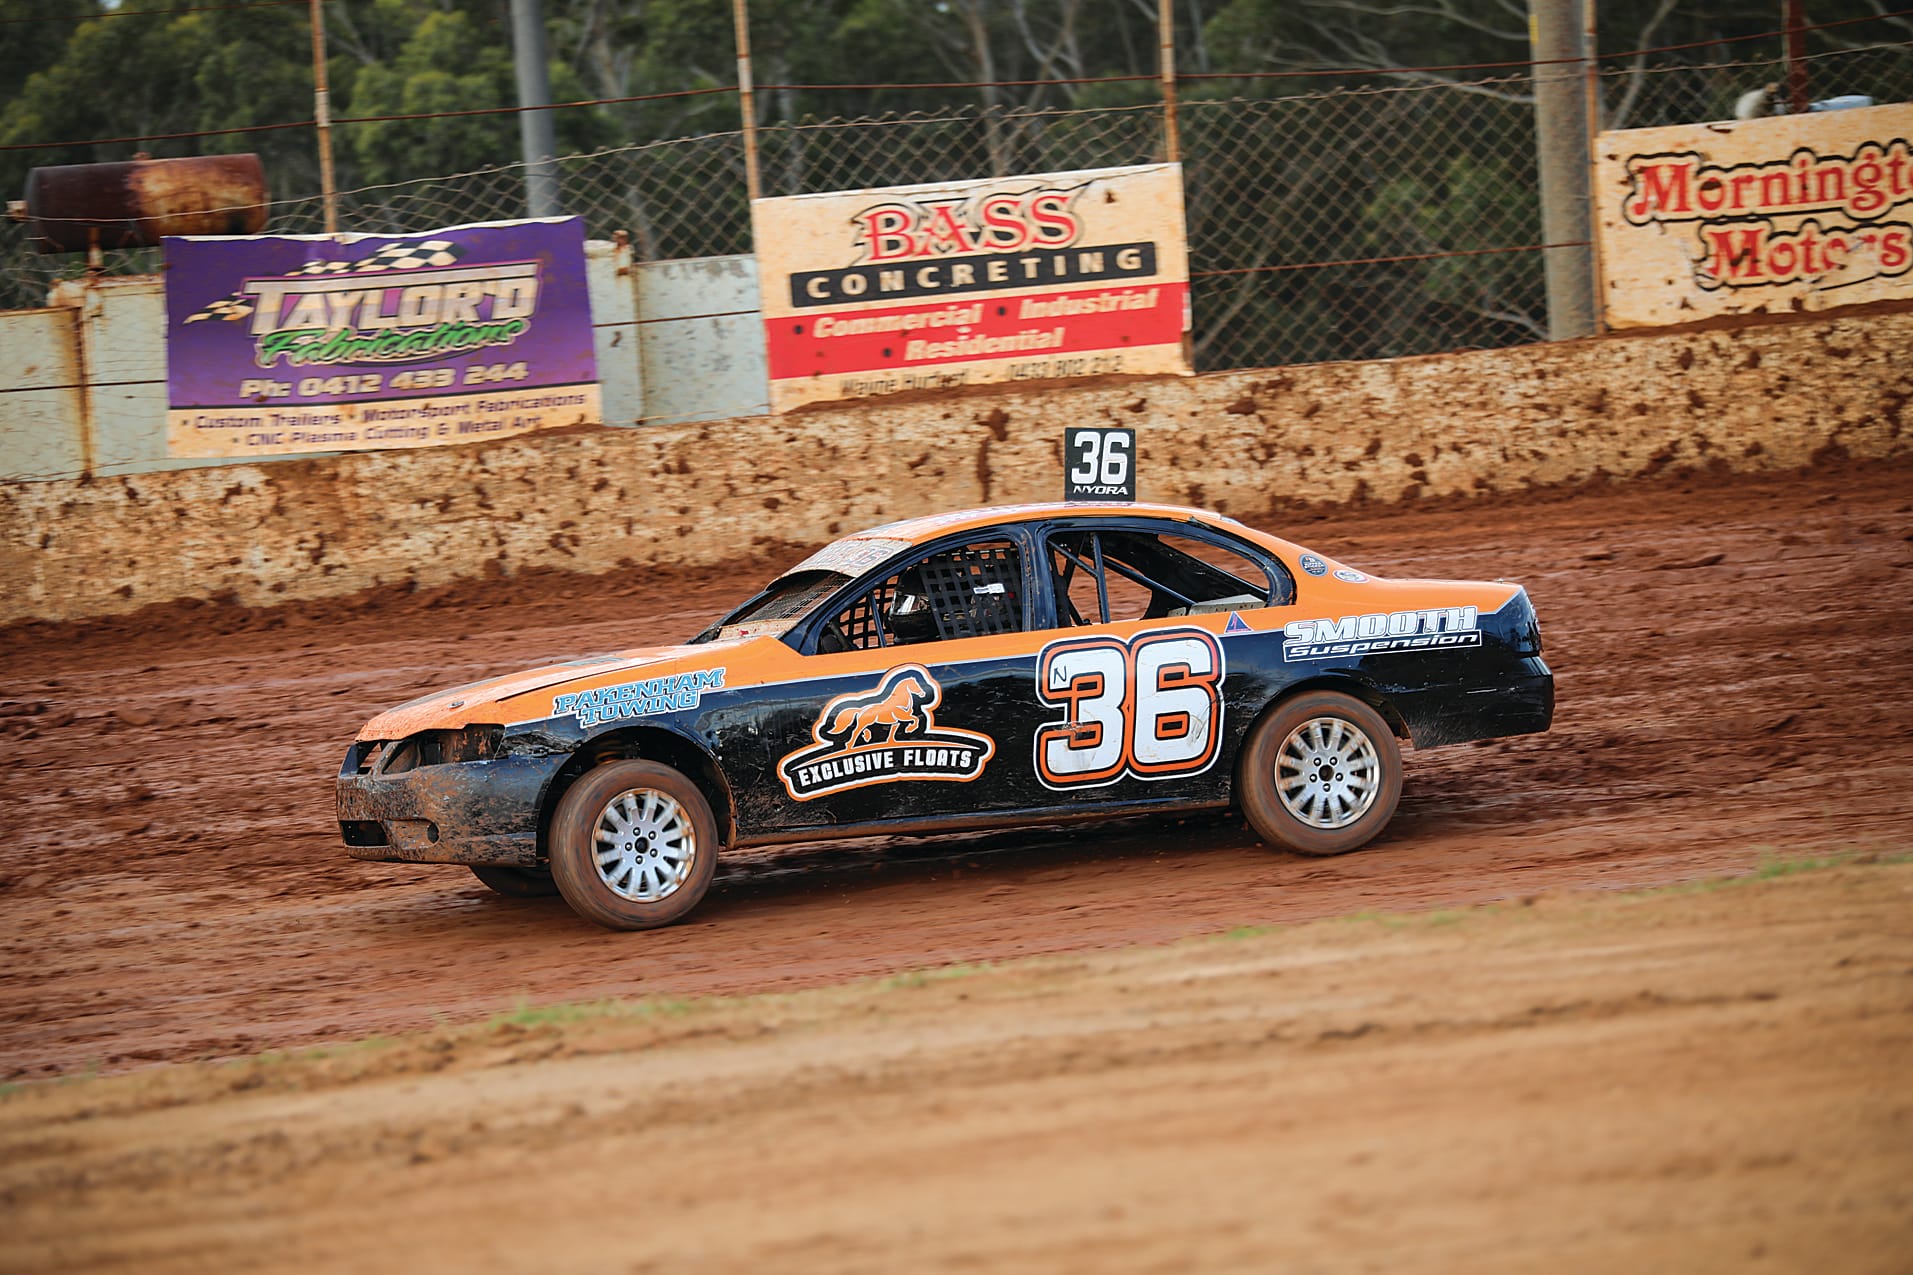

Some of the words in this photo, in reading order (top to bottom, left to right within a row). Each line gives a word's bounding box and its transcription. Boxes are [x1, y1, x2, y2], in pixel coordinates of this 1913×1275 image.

[1632, 151, 1913, 215] Morningt
[862, 194, 1079, 262] BASS
[806, 247, 1143, 298] CONCRETING
[243, 262, 540, 336] TAYLOR'D
[812, 303, 984, 339] Commercial
[1018, 288, 1159, 320] Industrial
[260, 319, 527, 364] Fabrications
[904, 327, 1065, 361] Residential
[240, 378, 292, 398] Ph:
[297, 374, 383, 397] 0412
[389, 367, 456, 390] 433
[463, 361, 529, 385] 244
[195, 414, 263, 429] Custom
[269, 412, 341, 428] Trailers
[363, 402, 470, 421] Motorsport
[477, 393, 587, 413] Fabrications
[247, 432, 284, 446] CNC
[291, 430, 357, 445] Plasma
[364, 424, 429, 440] Cutting
[437, 422, 449, 436] &
[457, 419, 503, 434] Metal
[512, 415, 542, 429] Art
[1071, 431, 1130, 485] 36
[1073, 485, 1129, 496] NYORA
[1283, 606, 1478, 645] SMOOTH
[1288, 633, 1479, 658] Suspension
[554, 668, 726, 714] PAKENHAM
[579, 689, 699, 726] TOWING
[1041, 633, 1218, 782] 36
[798, 751, 894, 787] EXCLUSIVE
[903, 749, 972, 768] FLOATS
